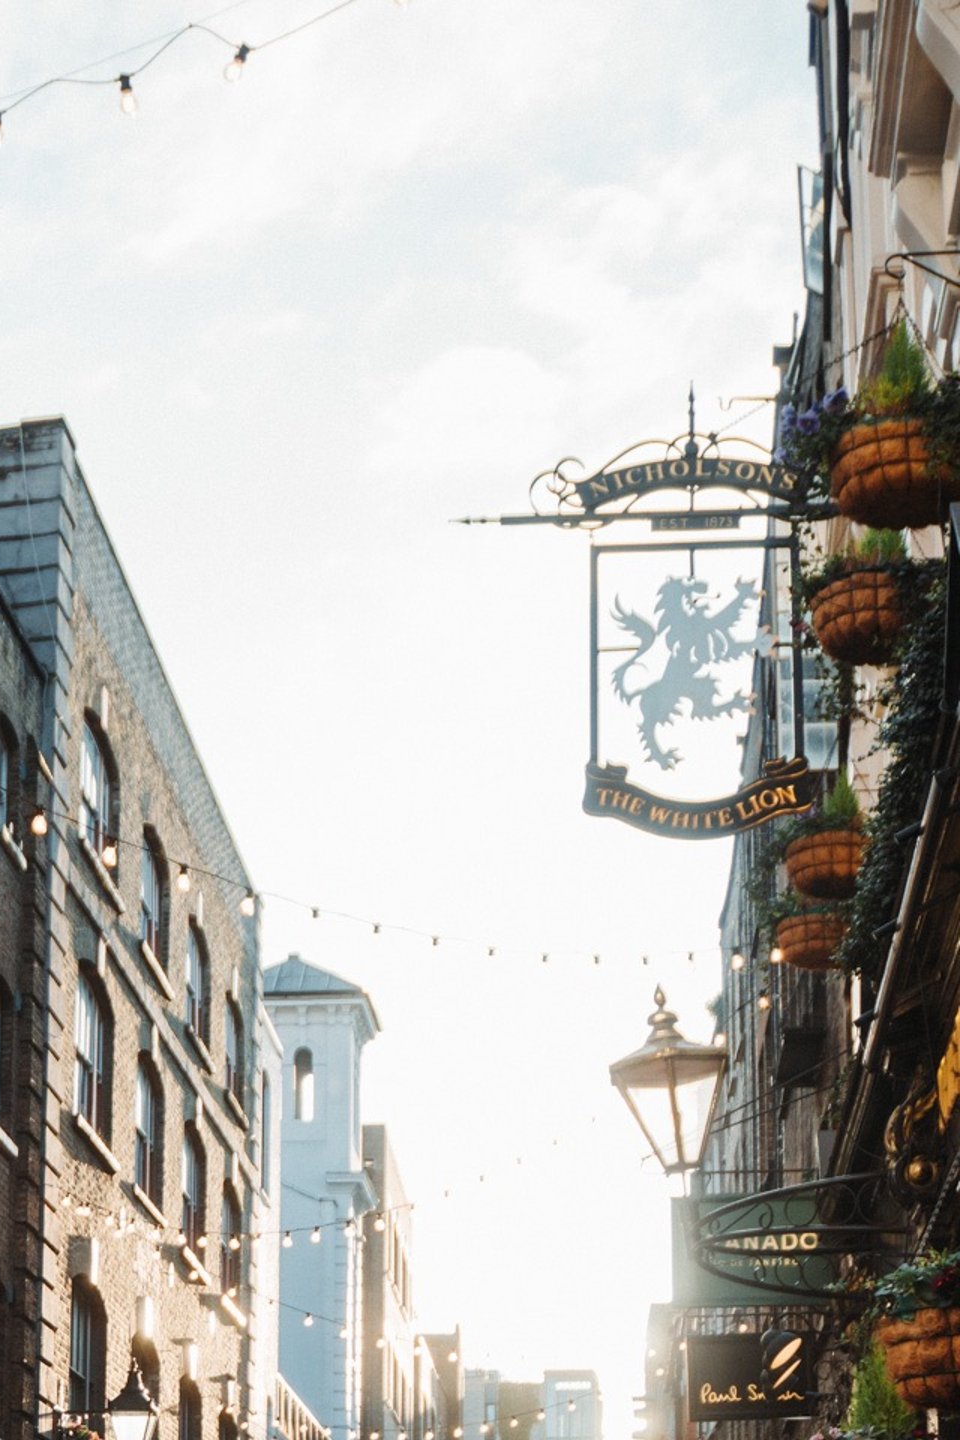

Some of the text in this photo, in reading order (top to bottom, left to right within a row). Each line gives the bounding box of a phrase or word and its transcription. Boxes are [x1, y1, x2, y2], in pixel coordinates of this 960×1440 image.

[590, 459, 797, 498] NICHOLSON'S
[704, 516, 733, 528] 1873
[596, 784, 798, 830] THE WHITE LION
[700, 1383, 742, 1404] Paul
